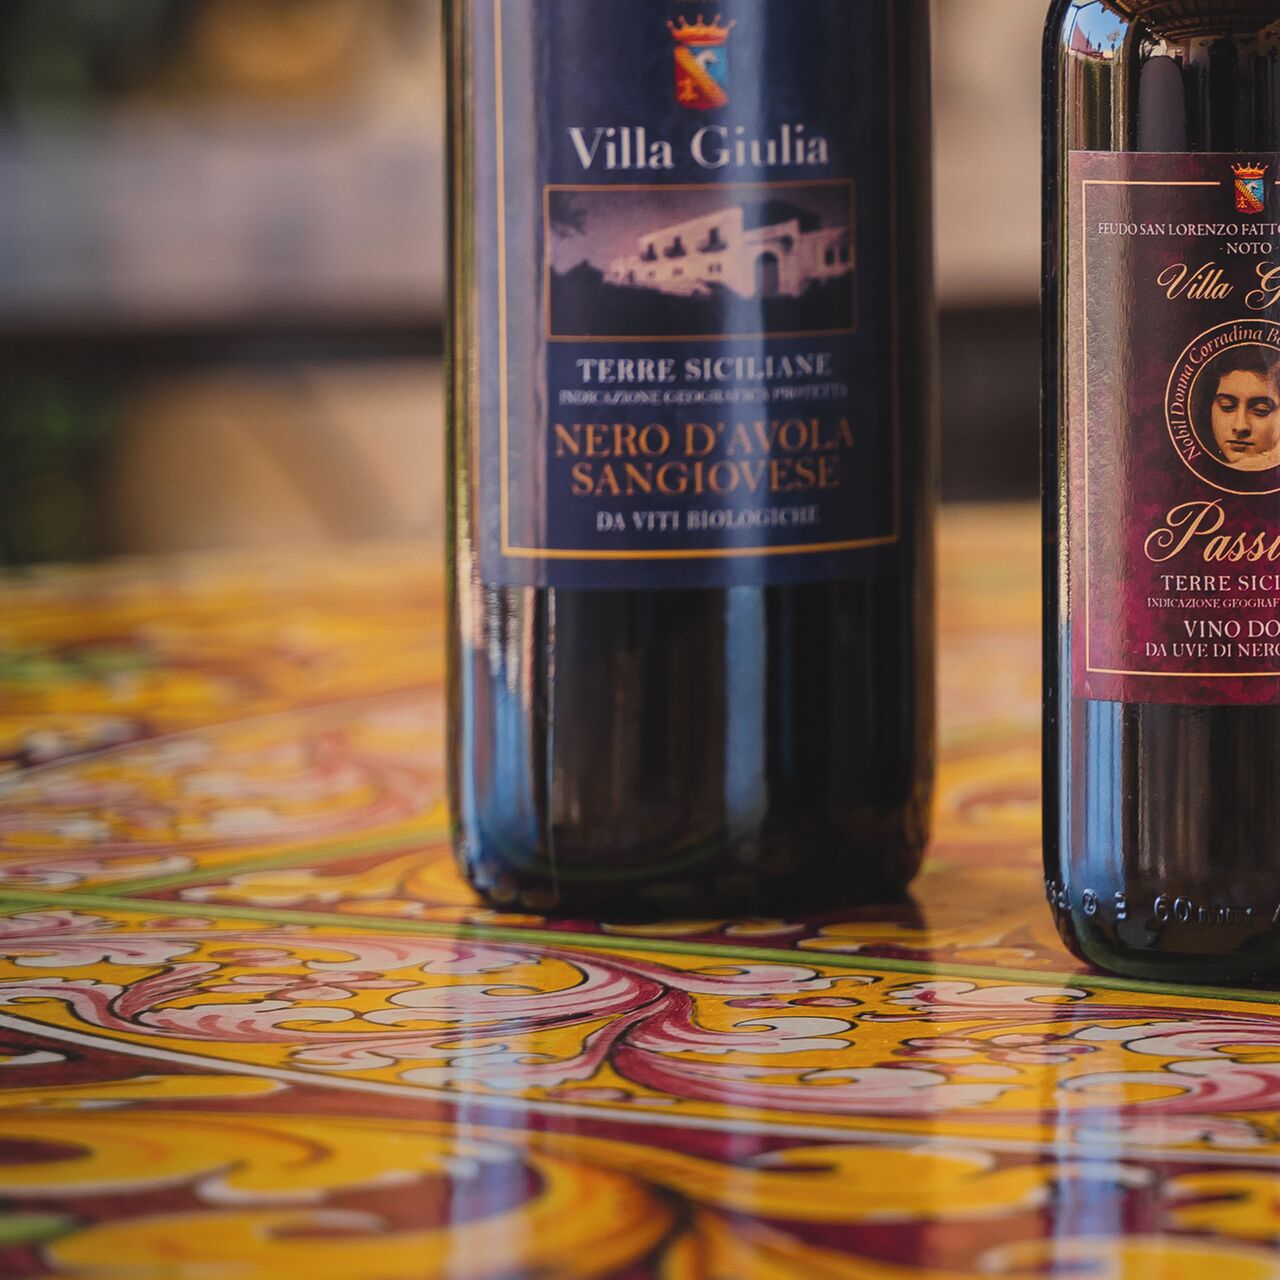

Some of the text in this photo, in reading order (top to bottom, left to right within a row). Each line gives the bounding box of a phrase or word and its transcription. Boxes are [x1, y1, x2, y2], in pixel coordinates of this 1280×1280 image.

[568, 123, 829, 170] Villa Giulia
[1098, 223, 1138, 236] FEUDO
[1139, 222, 1166, 236] SAN
[1168, 223, 1238, 236] LORENZO
[1226, 241, 1273, 255] NOTO
[1156, 260, 1235, 301] Villa
[575, 352, 833, 384] TERRE SICILIANE
[1170, 363, 1195, 417] Donna
[1189, 325, 1263, 365] Corradina
[553, 417, 855, 459] NERO D'AVOLA
[571, 455, 841, 498] SANGIOVESE
[596, 504, 821, 532] DA VITI BIOLOGICHE
[1161, 574, 1232, 592] TERRE
[1147, 597, 1221, 609] INDICAZIONE
[1183, 620, 1242, 639] VINO
[1145, 642, 1167, 657] DA
[1172, 642, 1209, 658] UVE
[1213, 642, 1233, 658] DI
